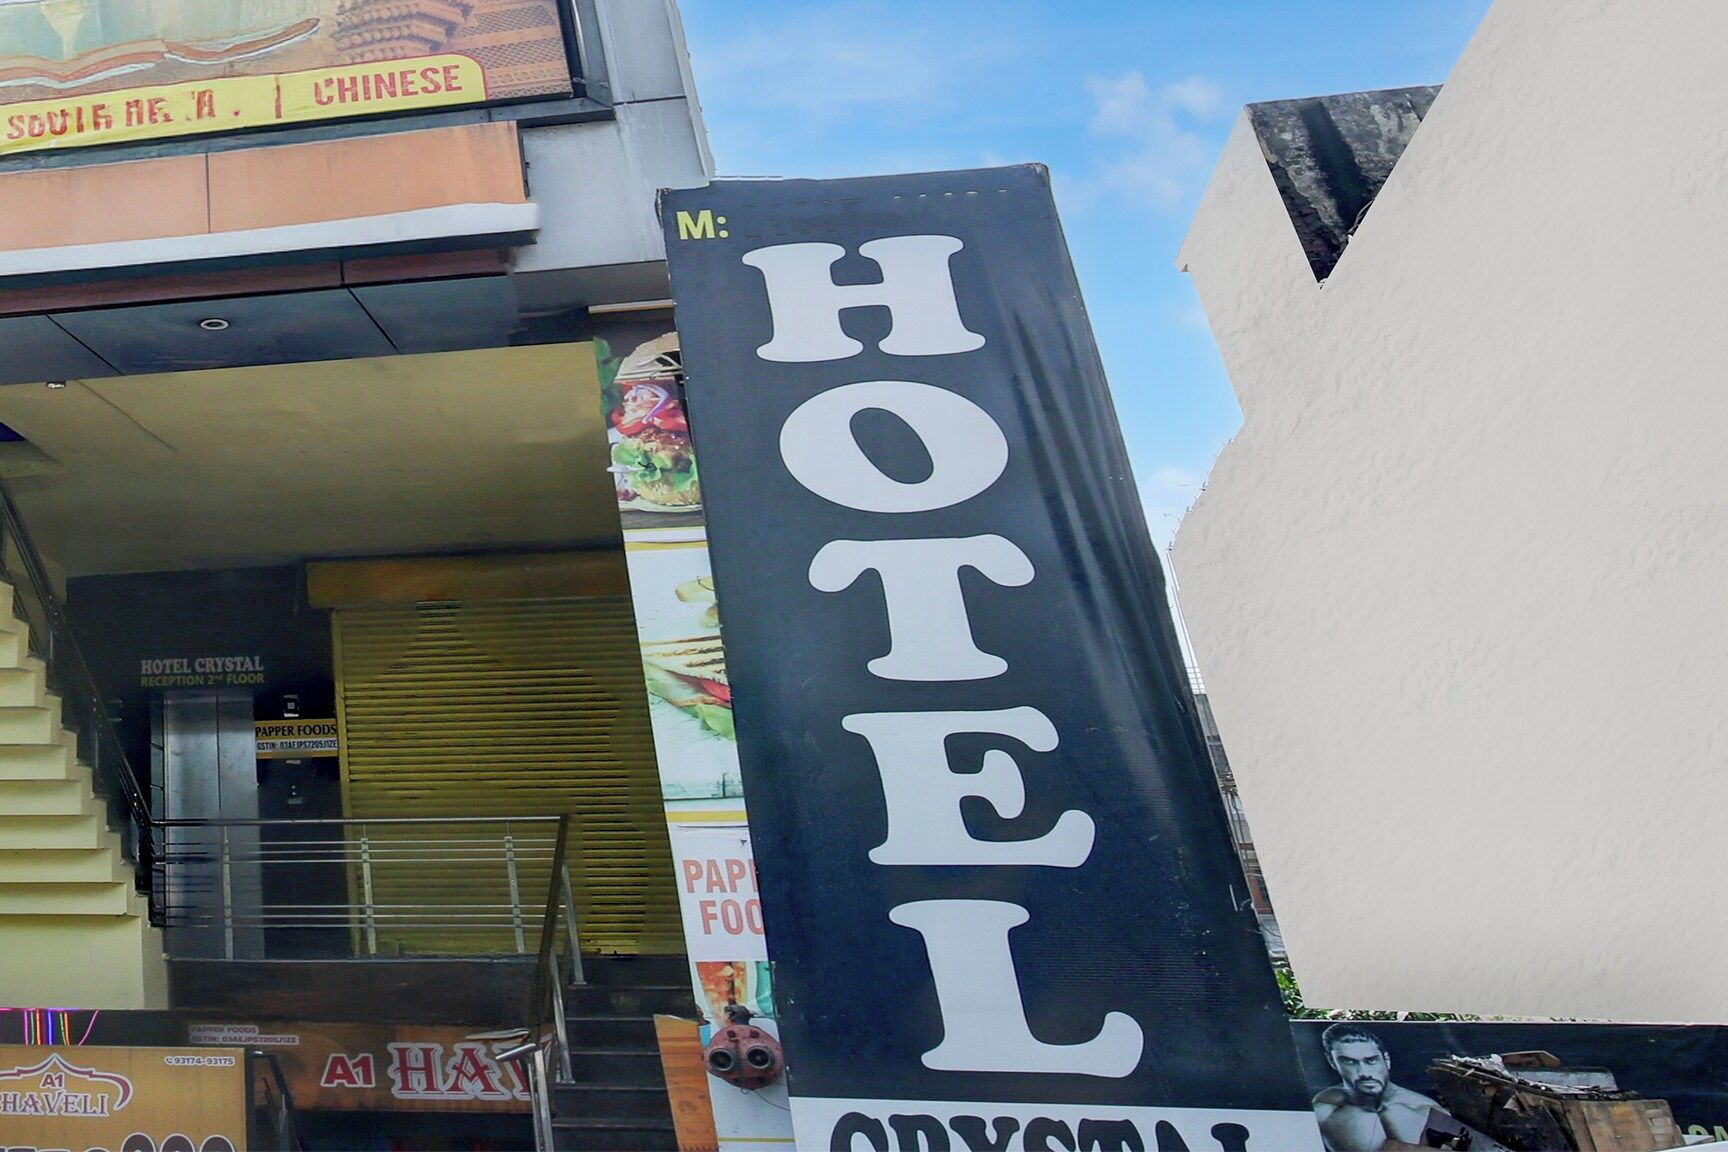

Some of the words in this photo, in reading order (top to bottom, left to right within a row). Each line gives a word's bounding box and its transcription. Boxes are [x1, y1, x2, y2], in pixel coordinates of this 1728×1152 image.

[313, 64, 463, 107] CHINESE
[140, 659, 192, 675] HOTEL
[193, 655, 265, 673] CRYSTAL
[741, 234, 1145, 1079] HOTEL
[140, 675, 205, 688] RECEPTION
[226, 672, 265, 685] FLOOR
[255, 725, 295, 738] PAPPER
[297, 723, 338, 736] FOODS
[40, 1073, 64, 1089] A1
[322, 1054, 374, 1087] A1
[0, 1092, 110, 1116] HAVELI
